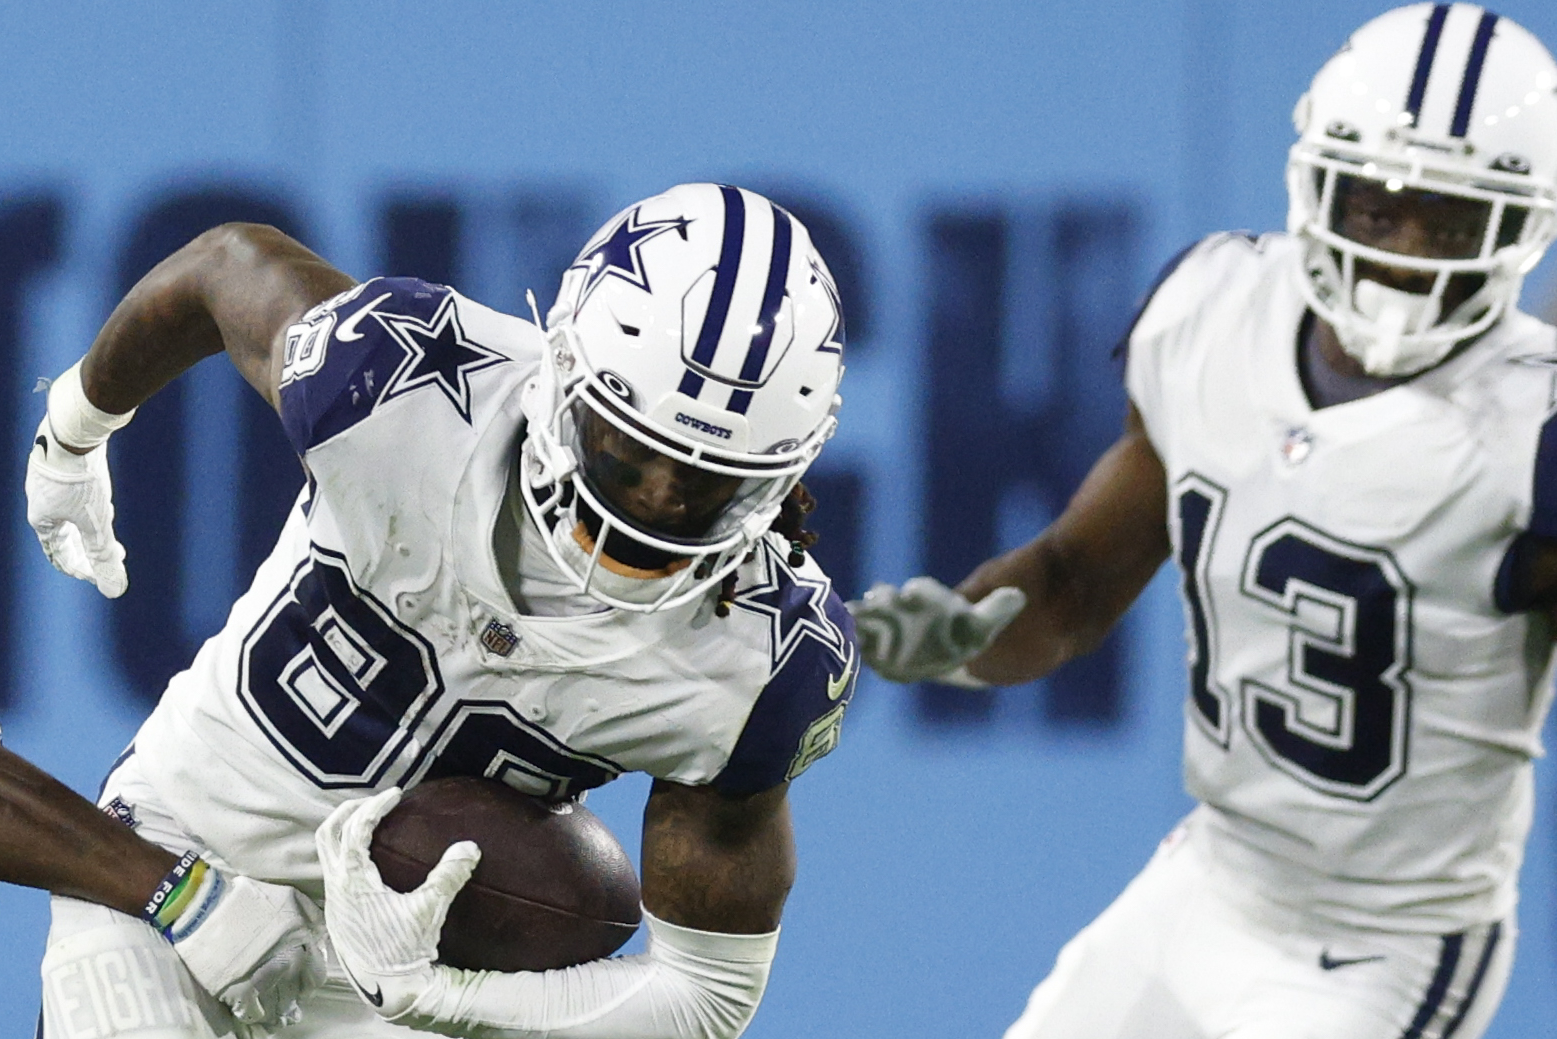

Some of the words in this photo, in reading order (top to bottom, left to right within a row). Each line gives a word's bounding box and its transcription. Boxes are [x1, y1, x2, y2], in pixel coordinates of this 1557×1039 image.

[675, 412, 733, 440] COWBOYS
[1174, 471, 1416, 803] 13
[145, 880, 174, 915] FOR
